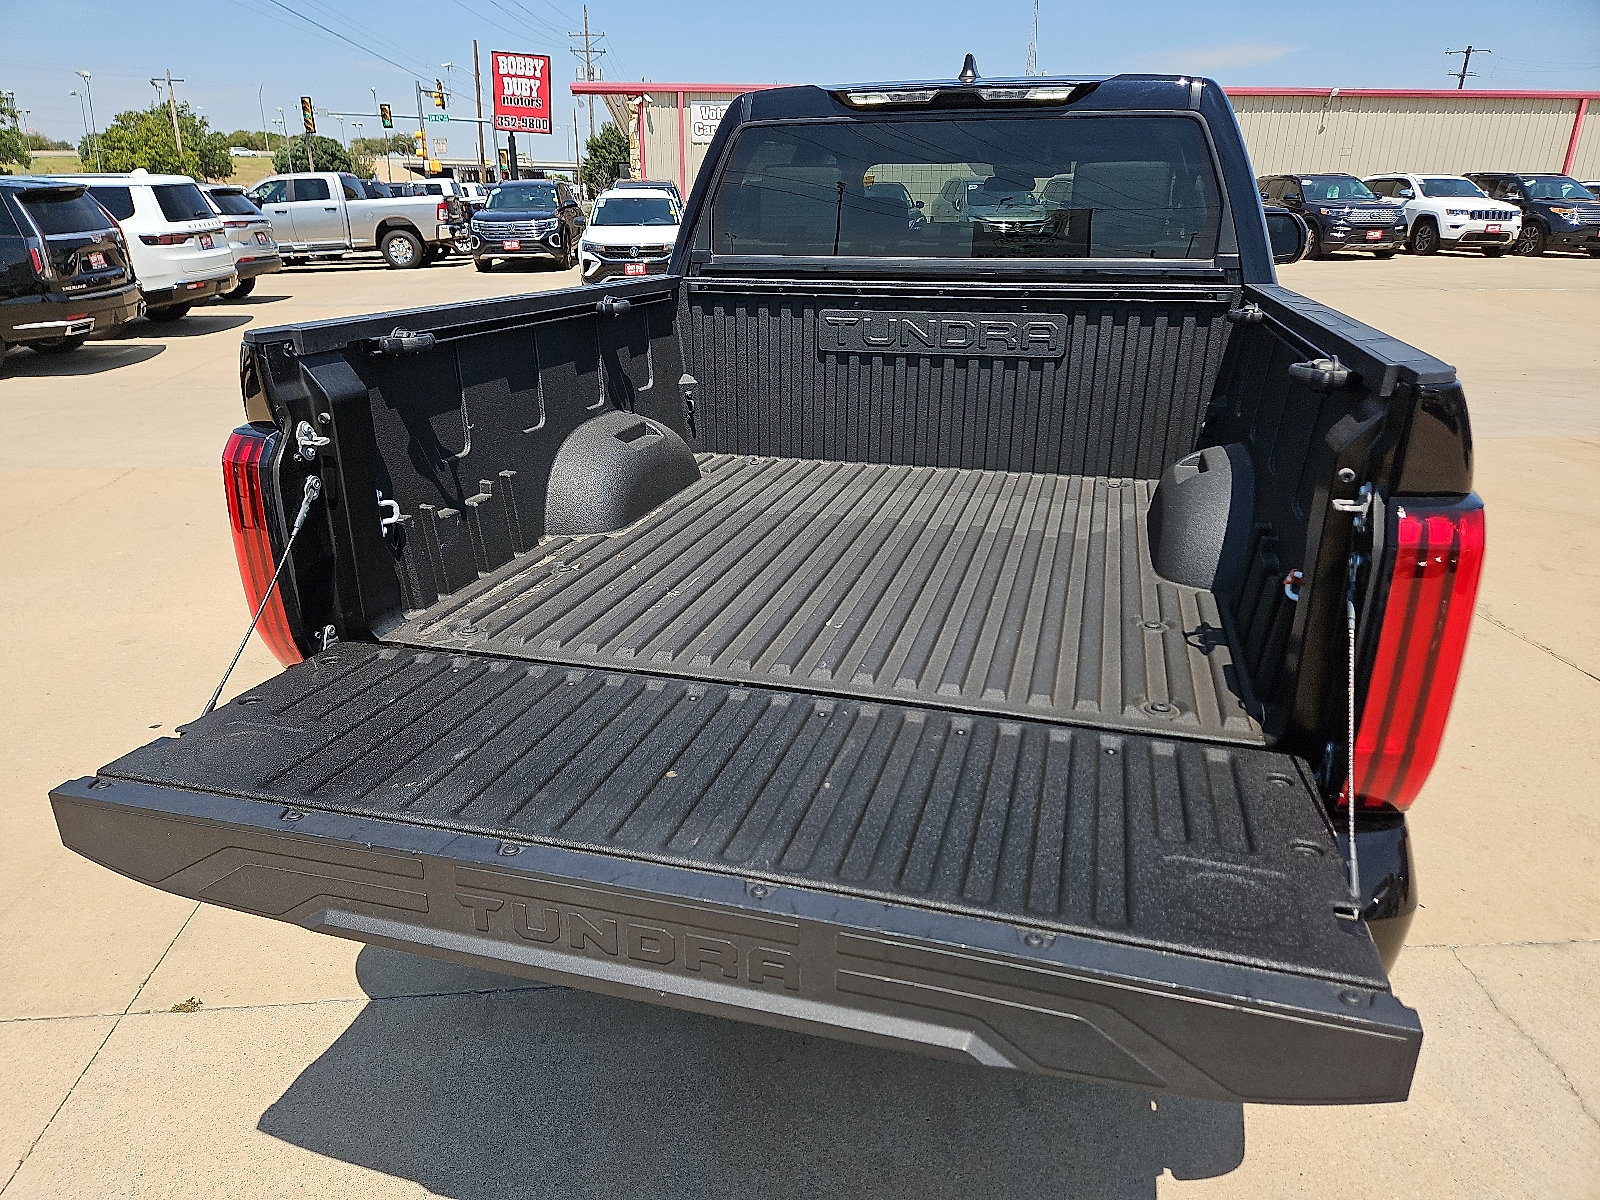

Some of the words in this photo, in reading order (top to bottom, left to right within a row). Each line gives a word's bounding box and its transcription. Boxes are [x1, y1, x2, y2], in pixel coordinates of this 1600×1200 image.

[497, 55, 545, 77] BOBBY
[502, 76, 541, 98] DUBY
[501, 95, 543, 109] motors
[497, 116, 548, 130] 352-9800
[825, 316, 1060, 351] TUNDRA
[454, 892, 801, 992] TUNDRA
